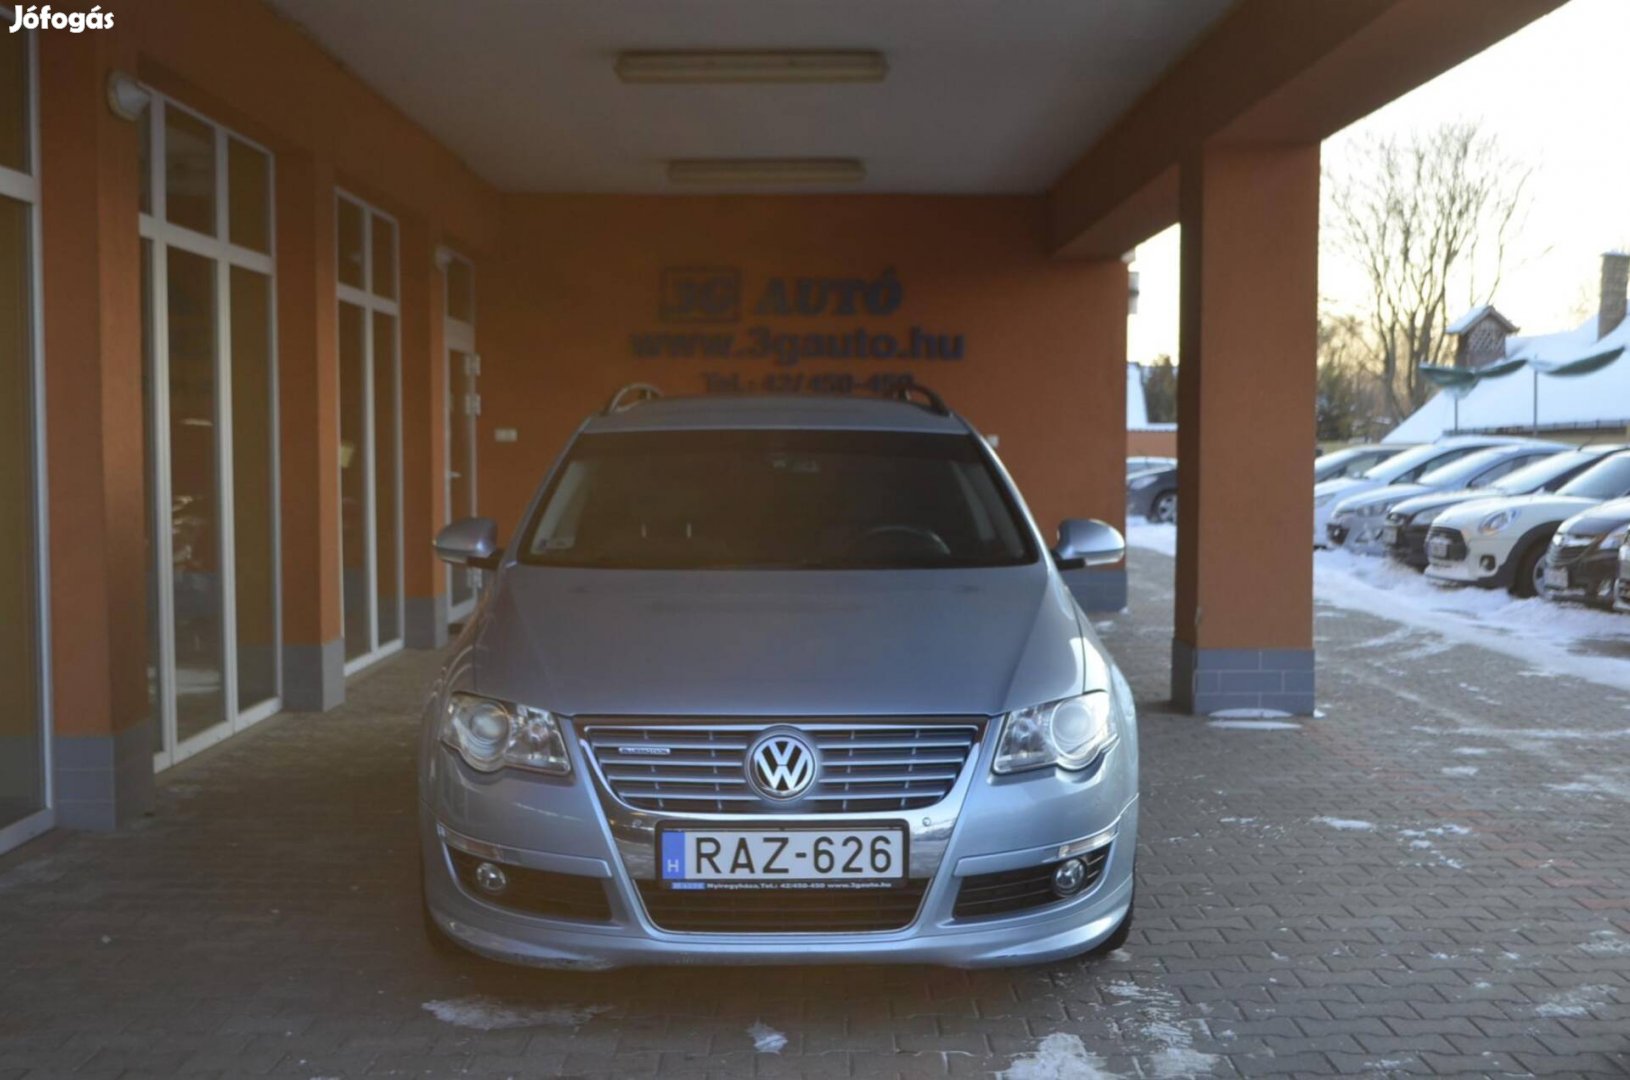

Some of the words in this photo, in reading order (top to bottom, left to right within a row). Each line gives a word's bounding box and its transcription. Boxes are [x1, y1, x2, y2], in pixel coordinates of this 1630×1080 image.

[756, 267, 904, 315] AUTÓ
[629, 326, 966, 365] www.3gauto.hu
[667, 858, 680, 873] H
[695, 835, 892, 874] RAZ-626
